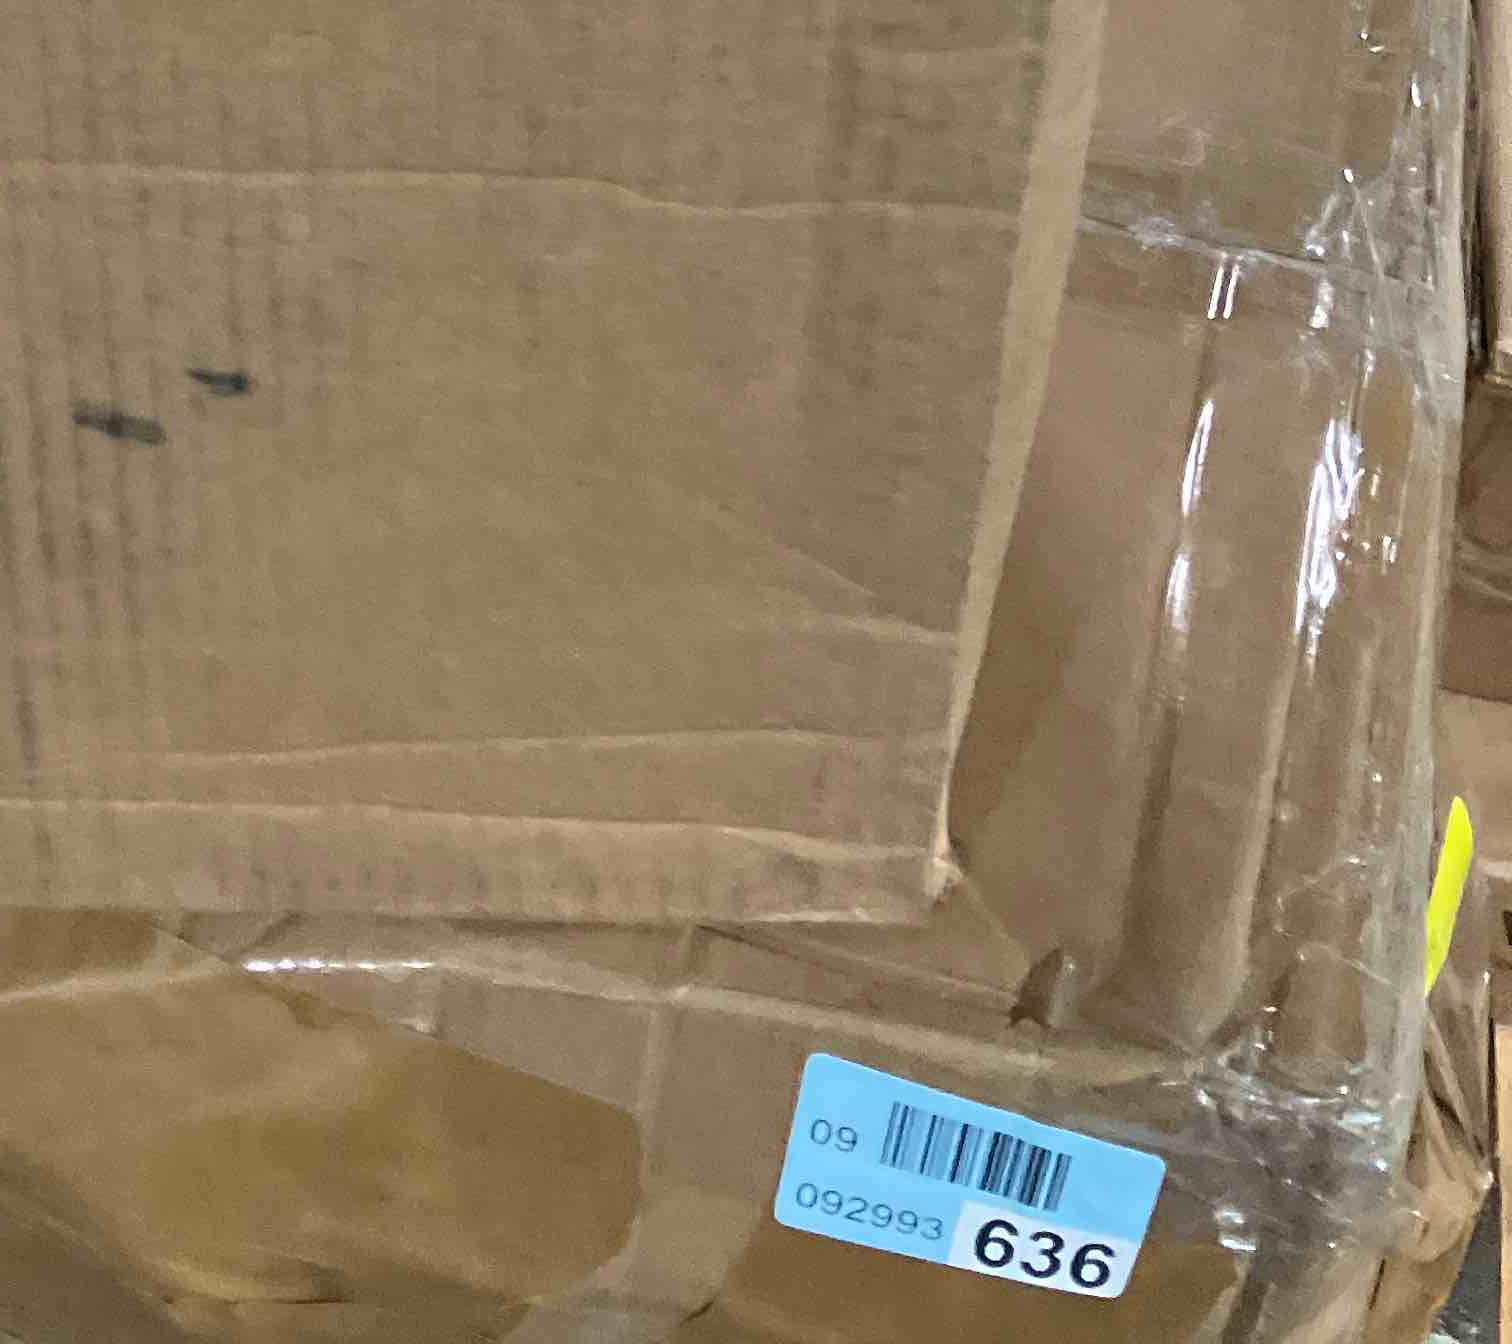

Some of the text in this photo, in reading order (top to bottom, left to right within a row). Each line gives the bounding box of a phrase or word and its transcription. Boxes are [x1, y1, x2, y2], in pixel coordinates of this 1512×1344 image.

[809, 1118, 858, 1153] 09
[795, 1181, 1116, 1289] 092993 636
